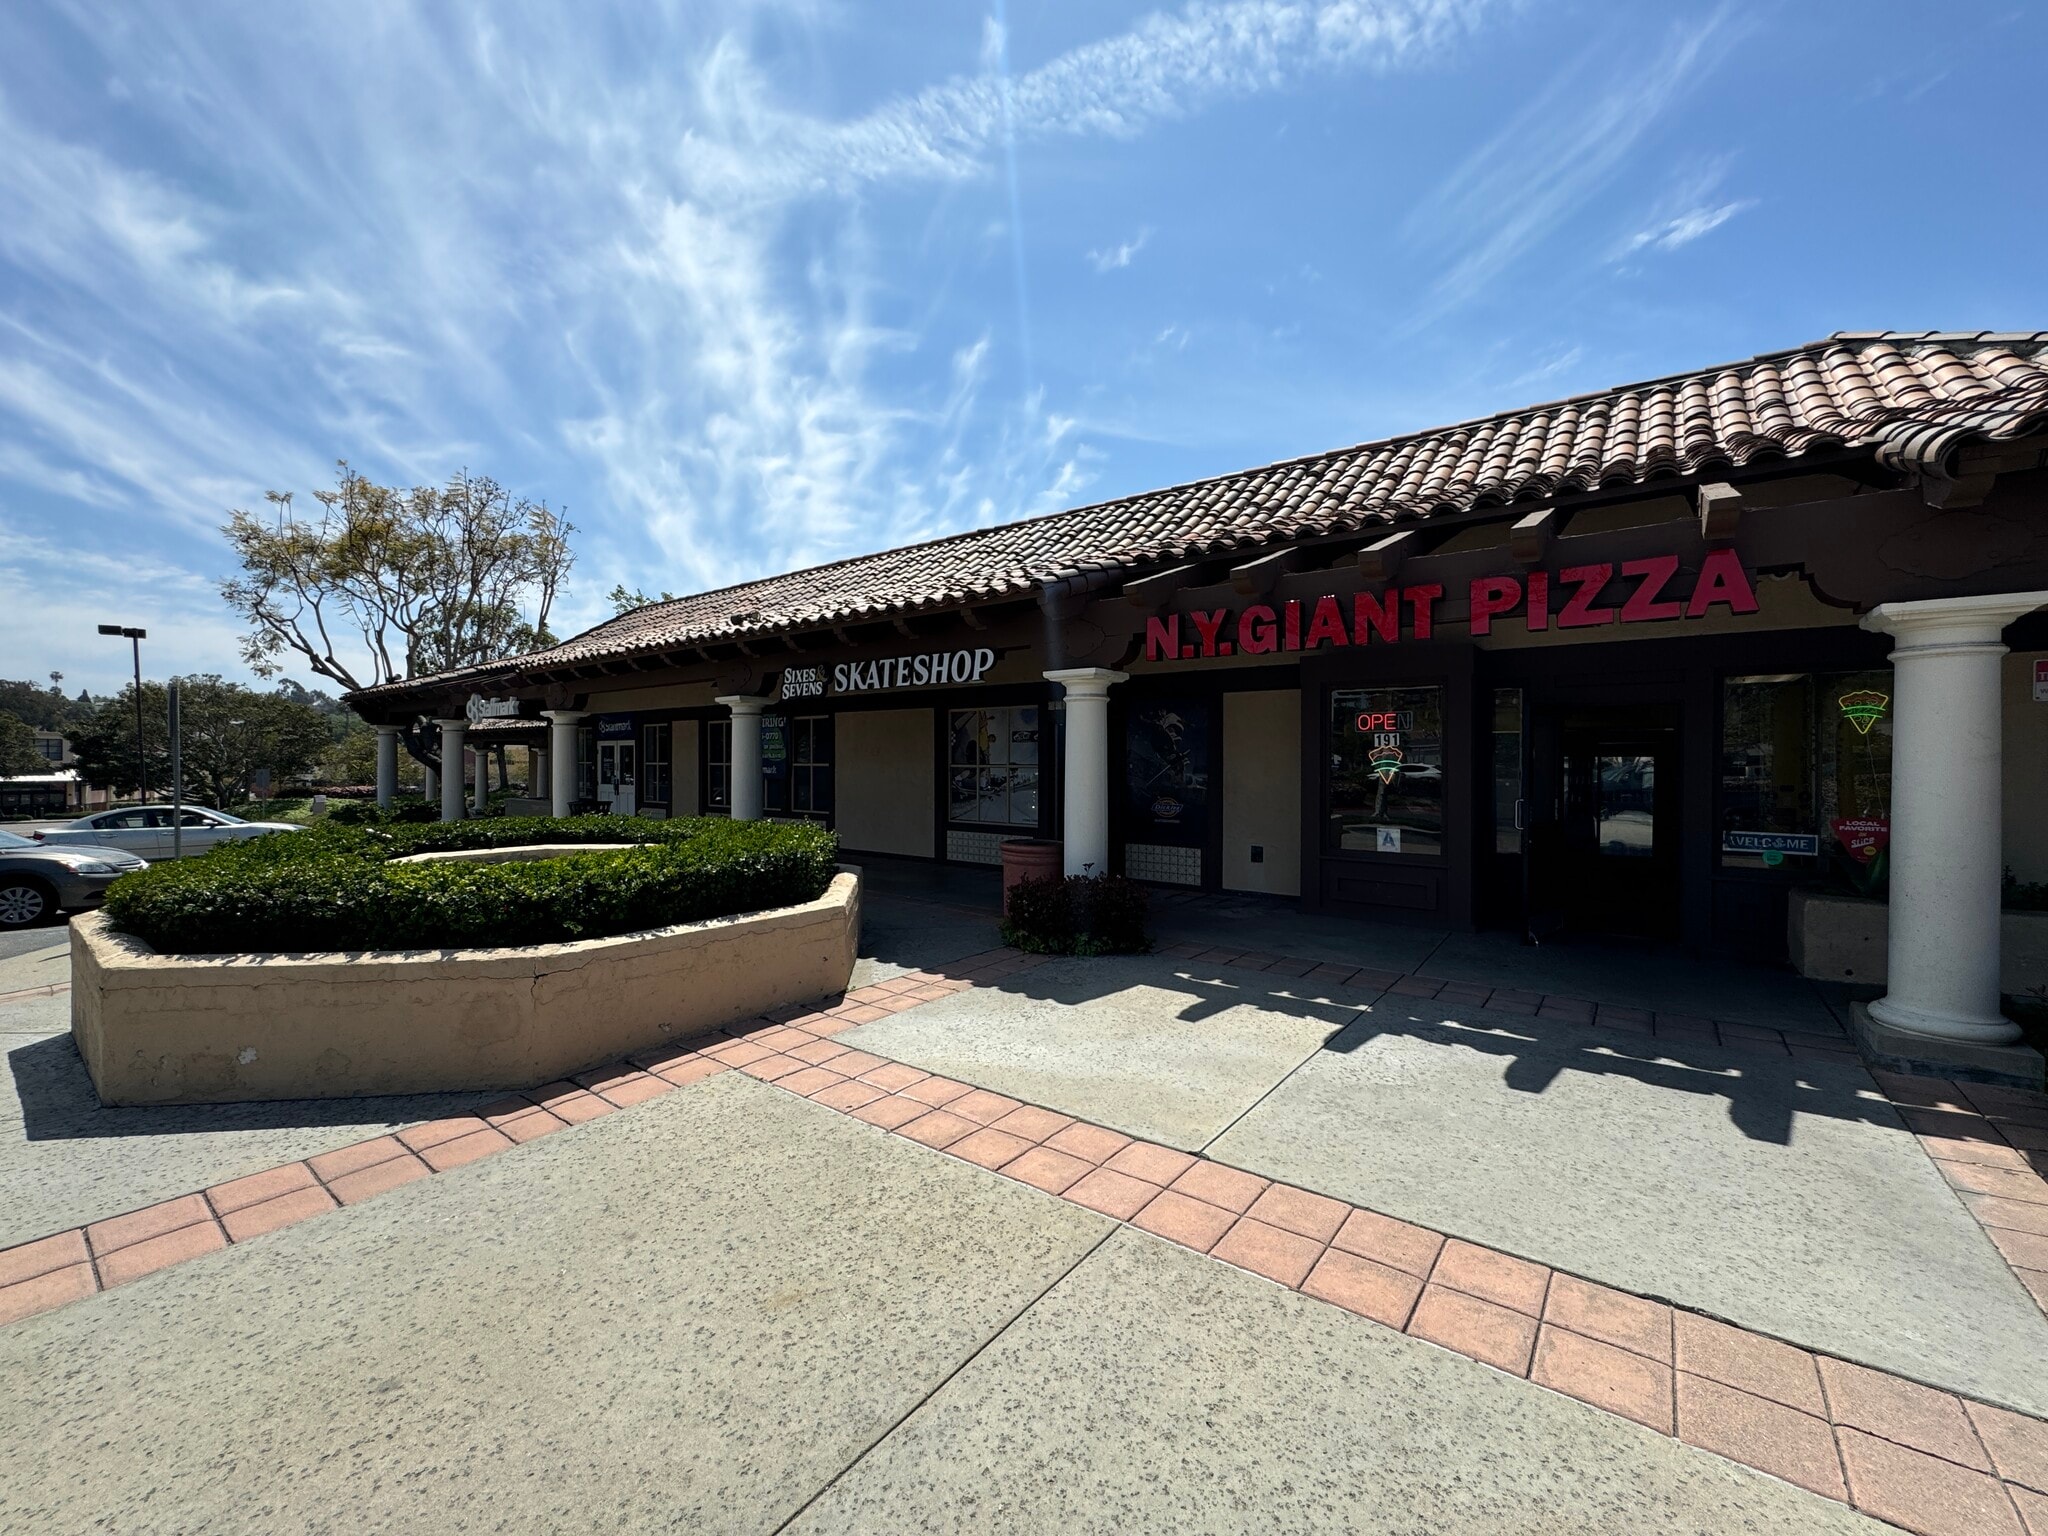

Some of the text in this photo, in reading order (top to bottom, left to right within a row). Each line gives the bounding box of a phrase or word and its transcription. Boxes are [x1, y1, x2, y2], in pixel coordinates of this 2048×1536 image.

[1470, 548, 1760, 637] PIZZA
[783, 667, 817, 685] SIXES
[834, 648, 995, 692] SKATESHOP
[782, 681, 824, 700] SEVENS
[761, 717, 786, 728] IRING!
[1357, 713, 1411, 731] OPEN
[1376, 734, 1398, 746] 191
[1382, 832, 1396, 847] A
